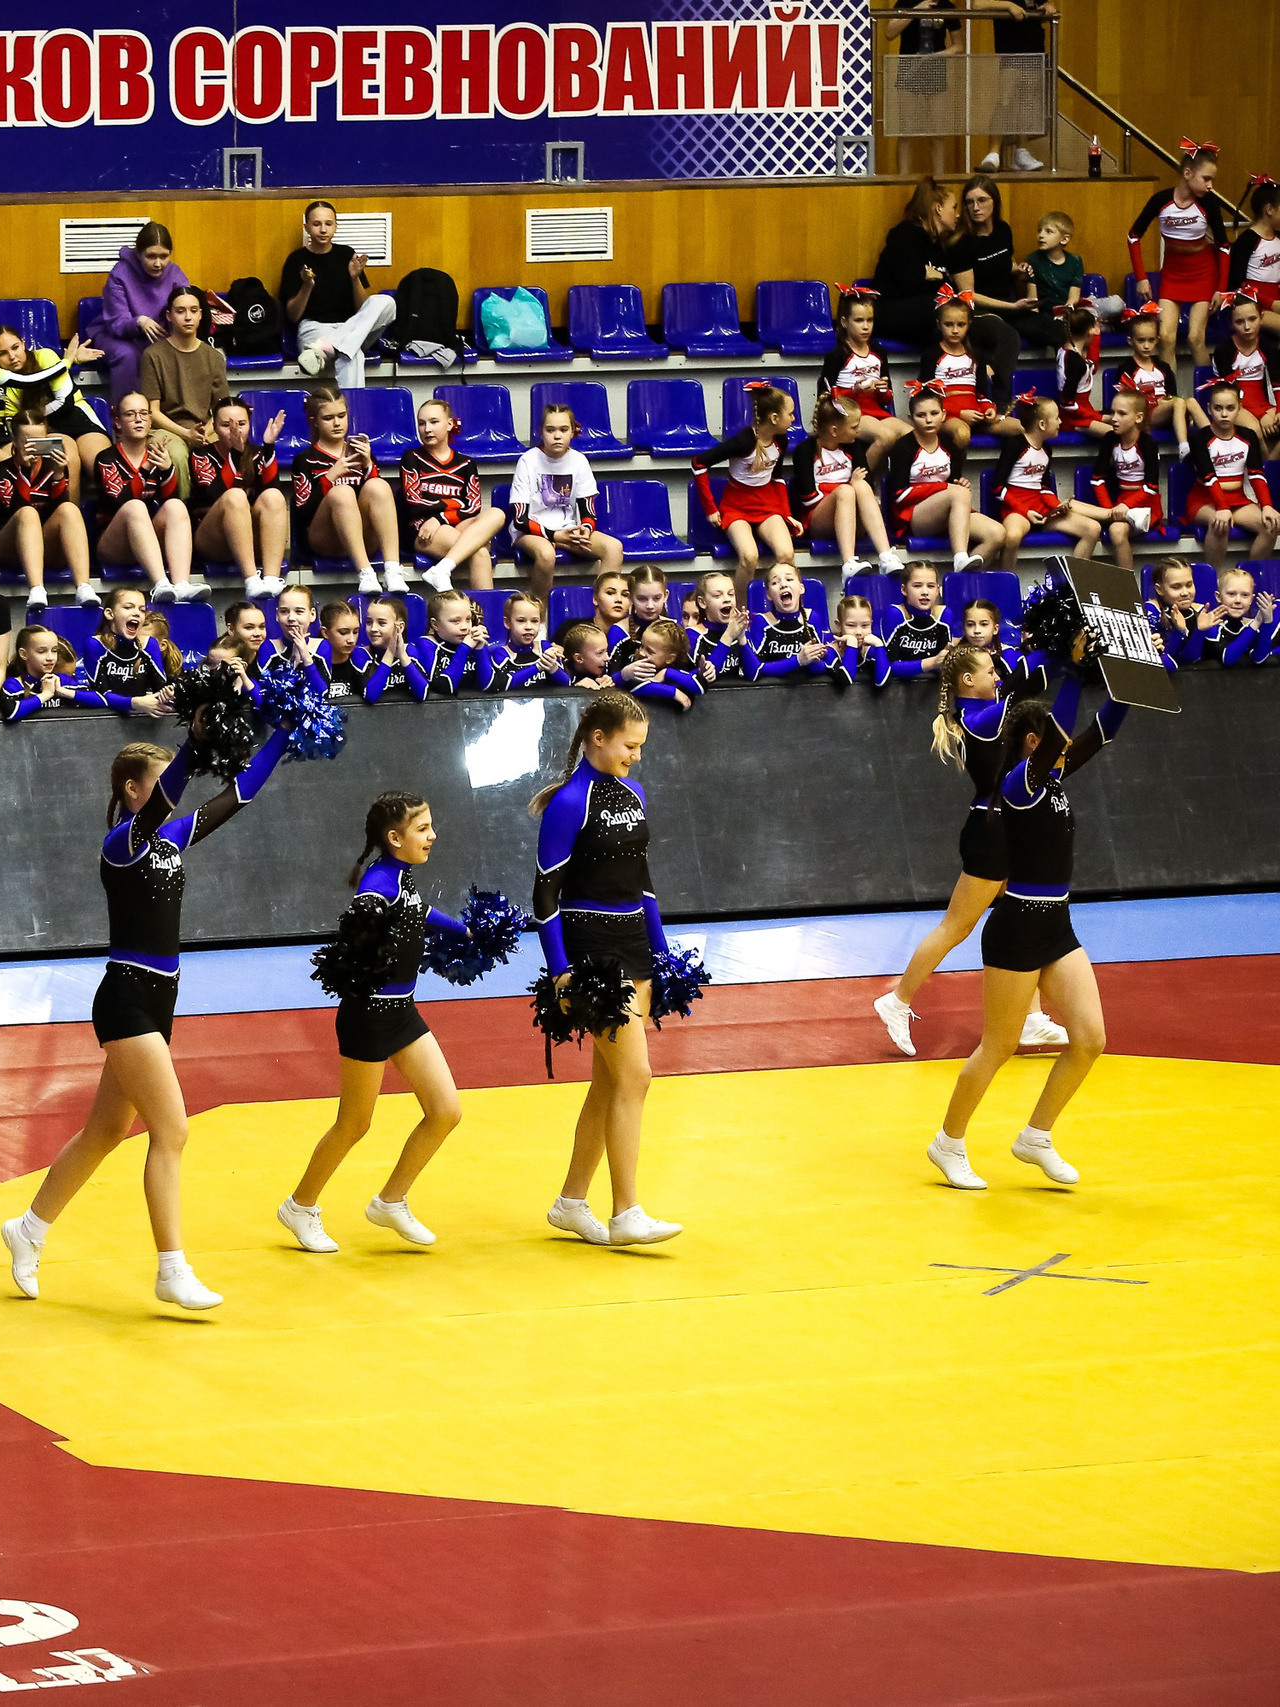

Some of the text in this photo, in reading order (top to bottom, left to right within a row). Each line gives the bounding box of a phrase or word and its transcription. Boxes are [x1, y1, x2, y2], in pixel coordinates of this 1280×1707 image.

[169, 3, 846, 124] СОРЕВНОВАНИЙ!
[899, 635, 937, 656] Bagira
[600, 807, 646, 831] Bagira
